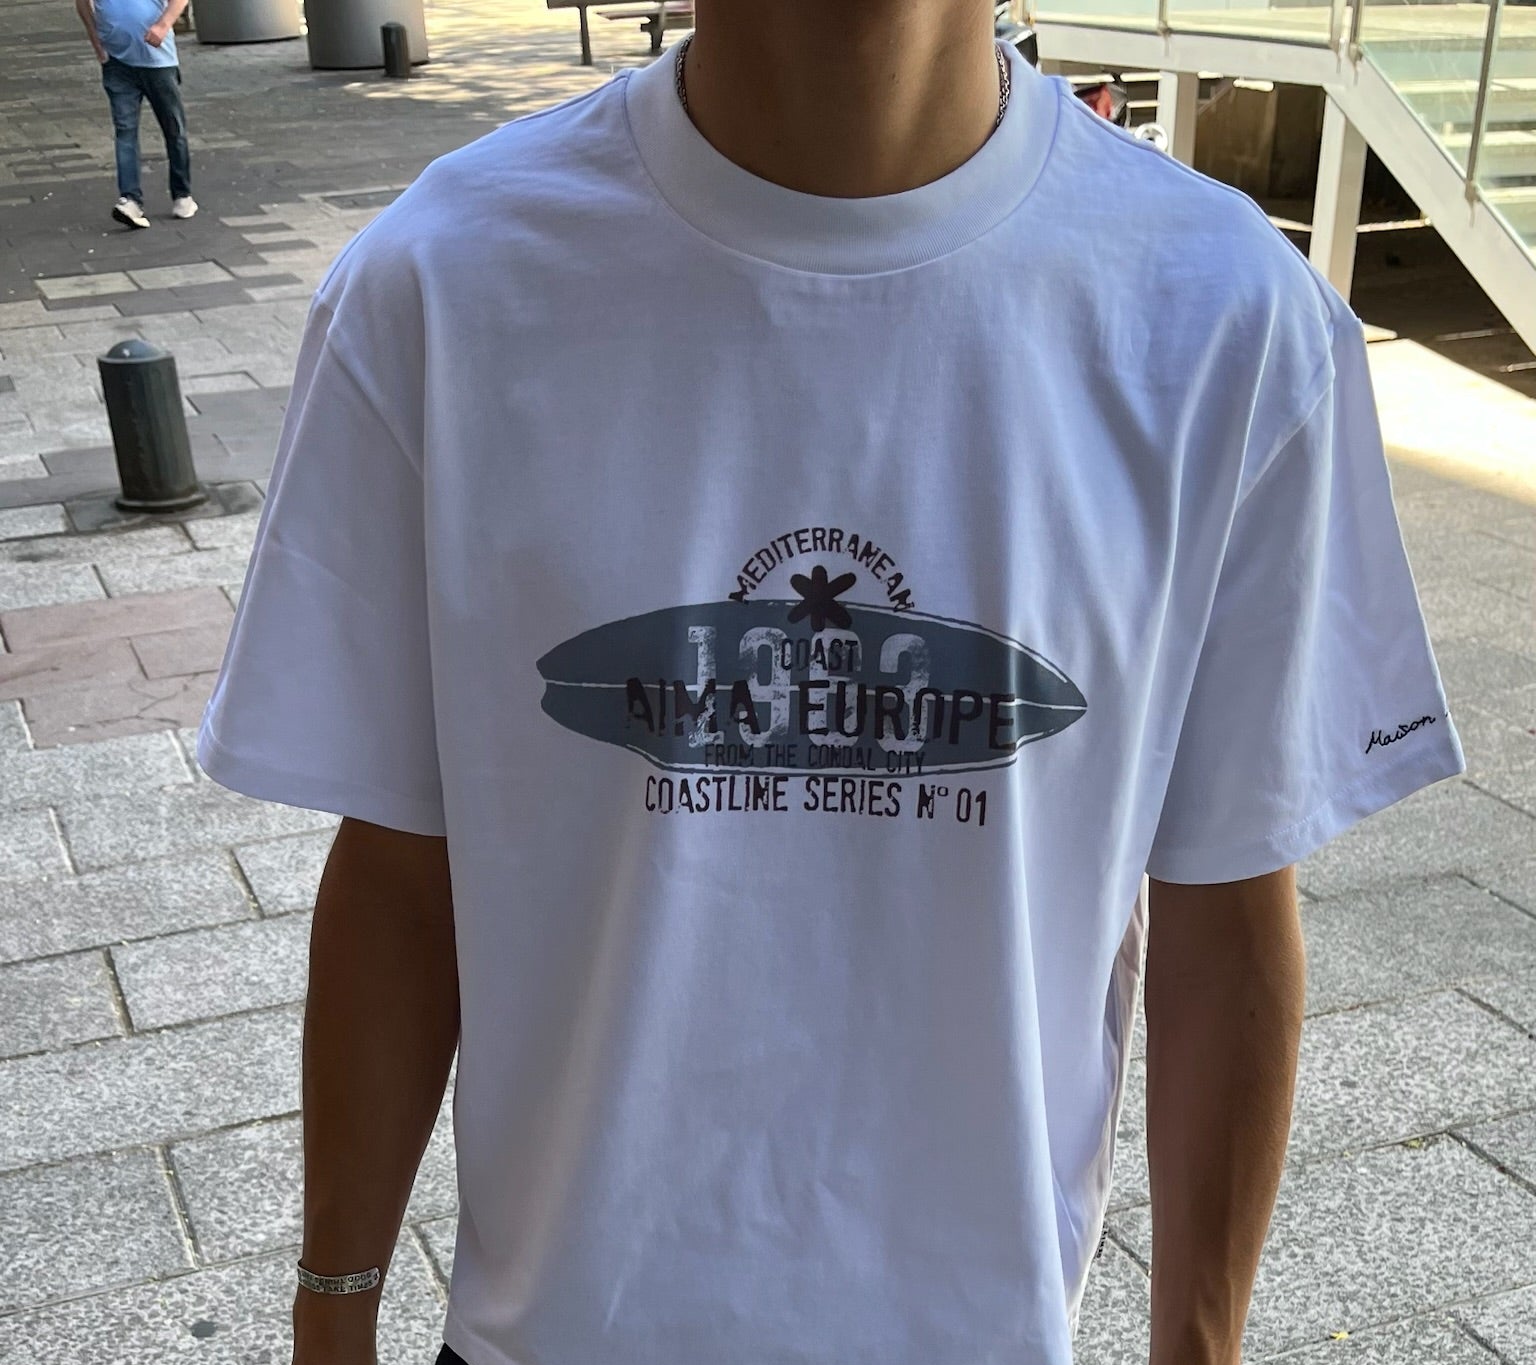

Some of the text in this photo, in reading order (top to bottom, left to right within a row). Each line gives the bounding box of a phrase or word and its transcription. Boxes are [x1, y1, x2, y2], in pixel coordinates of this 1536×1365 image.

[728, 527, 915, 612] MEDITERRANEAN
[781, 638, 858, 672] COAST
[799, 680, 1016, 749] EUROPE
[1365, 715, 1436, 754] Maison
[705, 743, 925, 775] FROM THE CONDAL CITY
[645, 775, 788, 814] COASTLINE
[804, 776, 902, 817] SERIES
[956, 788, 987, 826] 01
